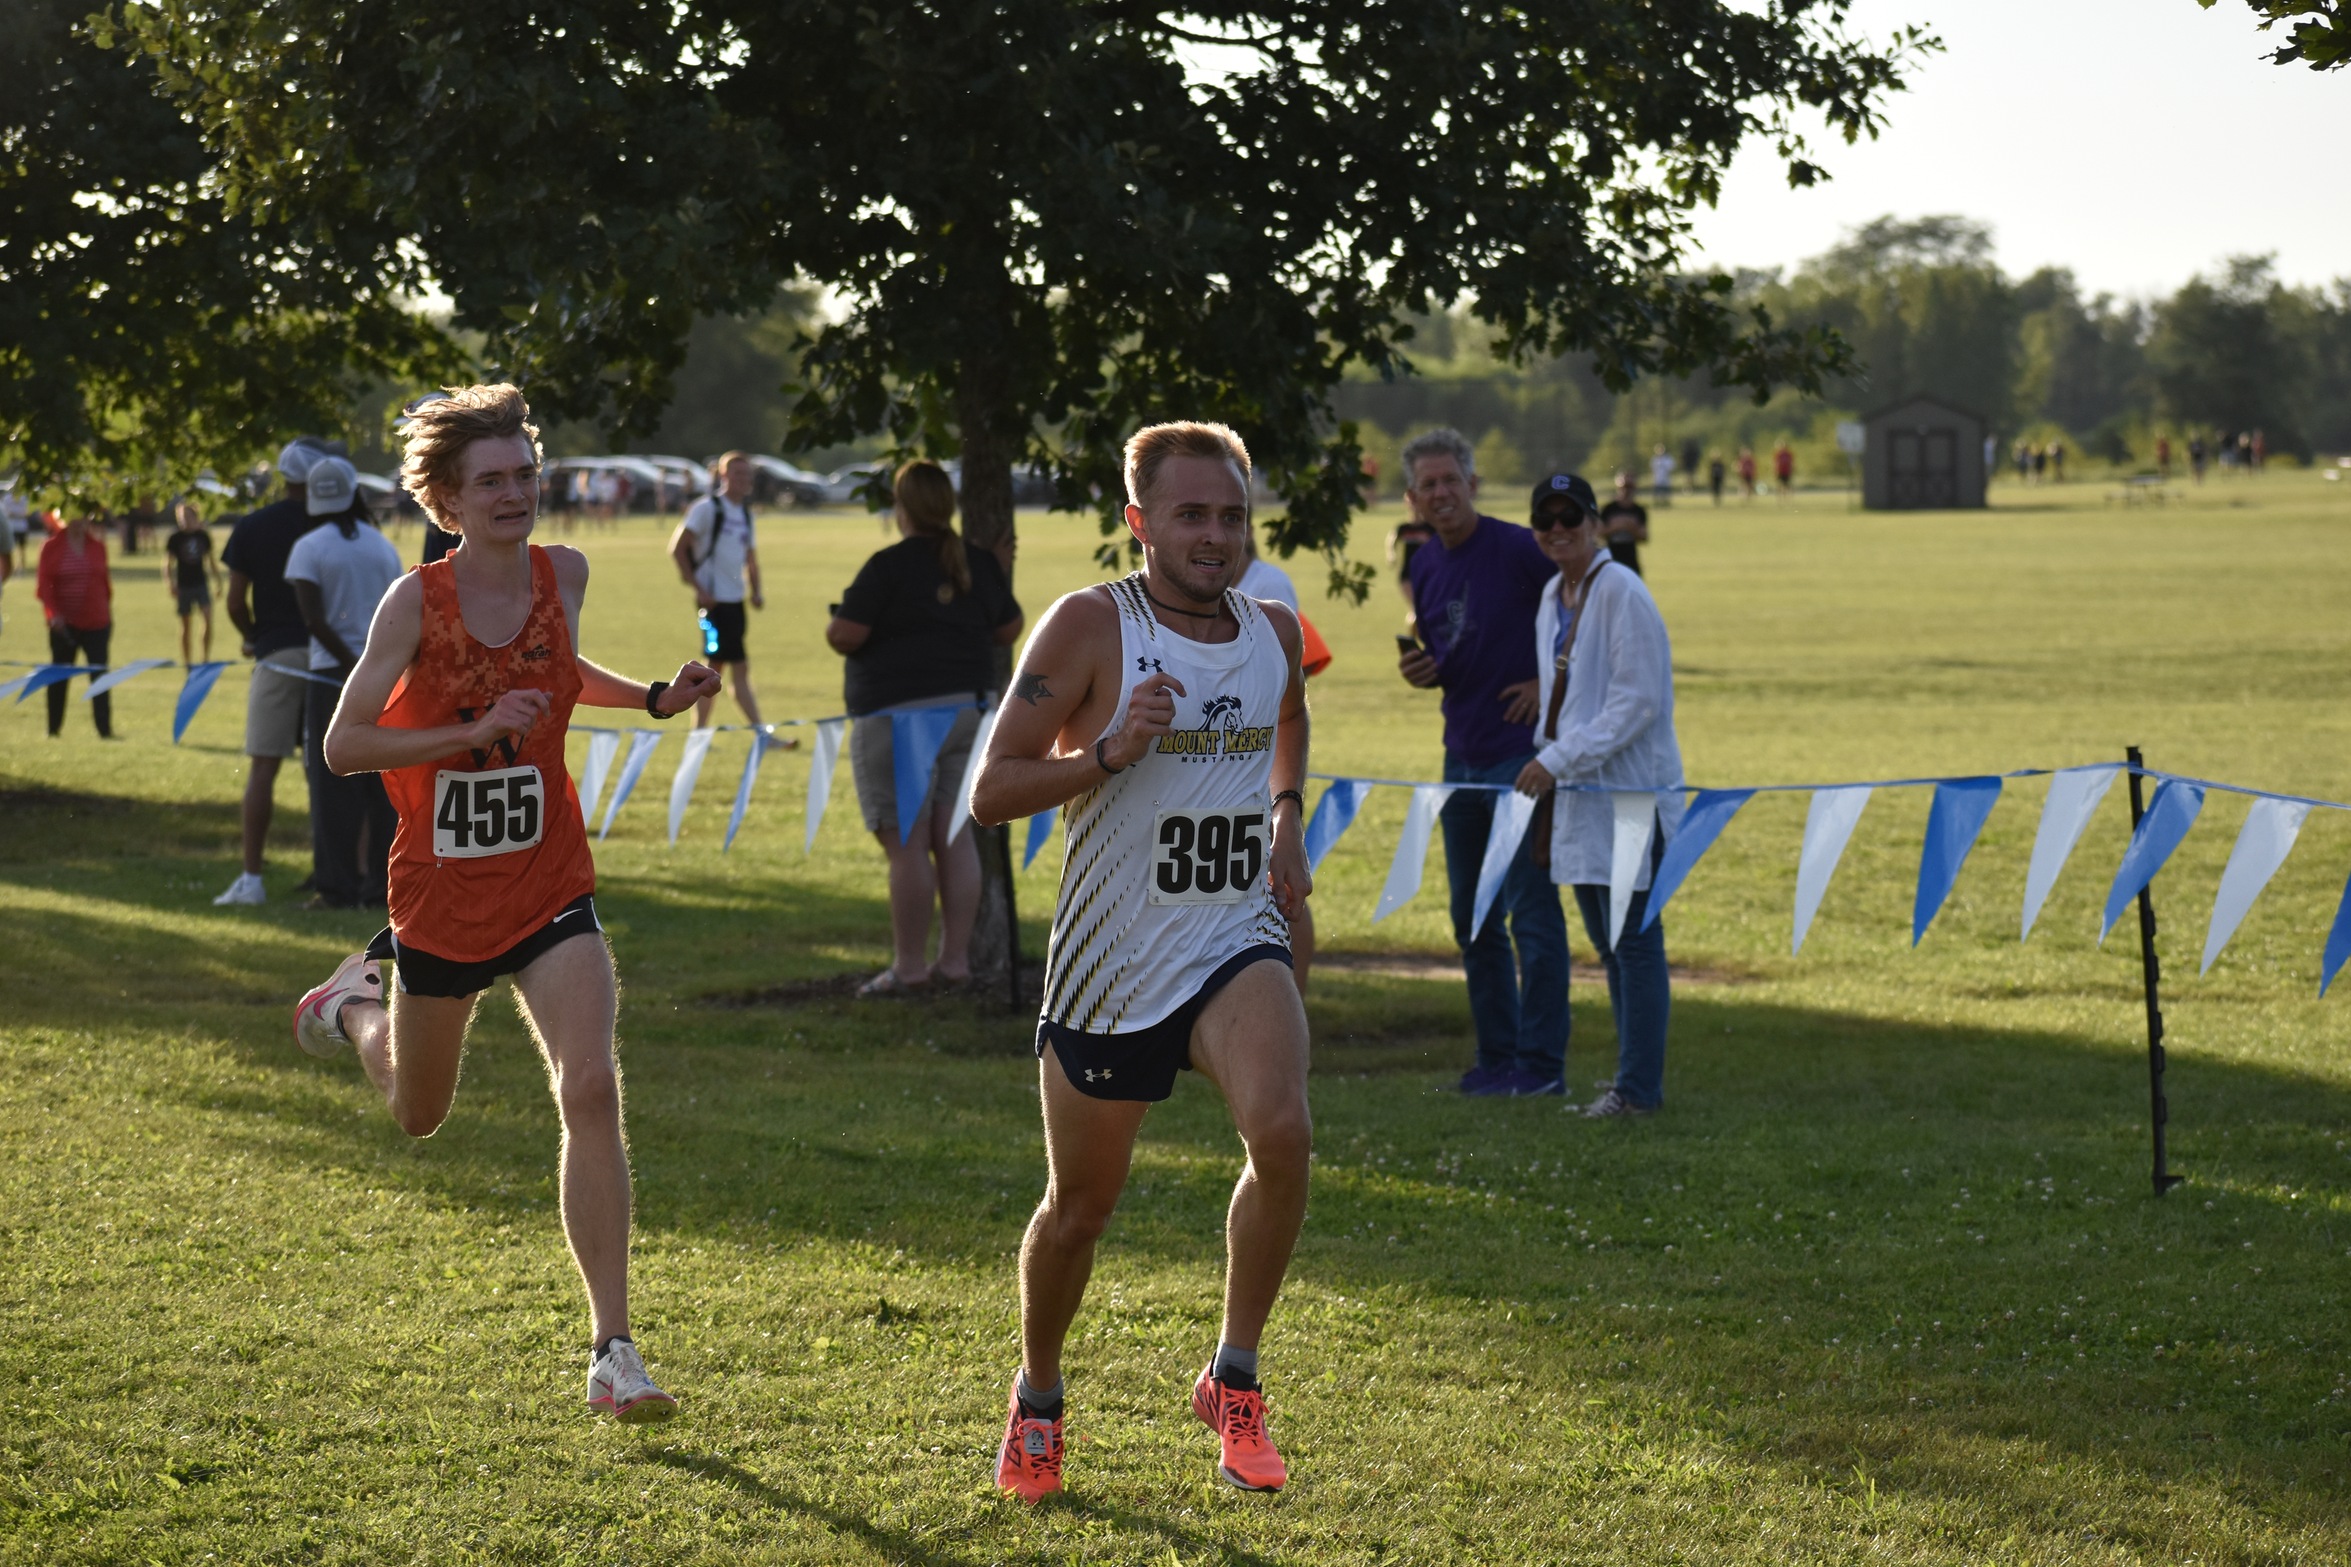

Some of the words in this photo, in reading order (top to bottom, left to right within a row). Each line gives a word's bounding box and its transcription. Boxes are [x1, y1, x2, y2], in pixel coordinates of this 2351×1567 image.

[1551, 475, 1570, 490] C
[1156, 730, 1221, 755] MOUNT
[1223, 726, 1274, 754] MERCY
[437, 774, 538, 848] 455
[1157, 813, 1264, 894] 395
